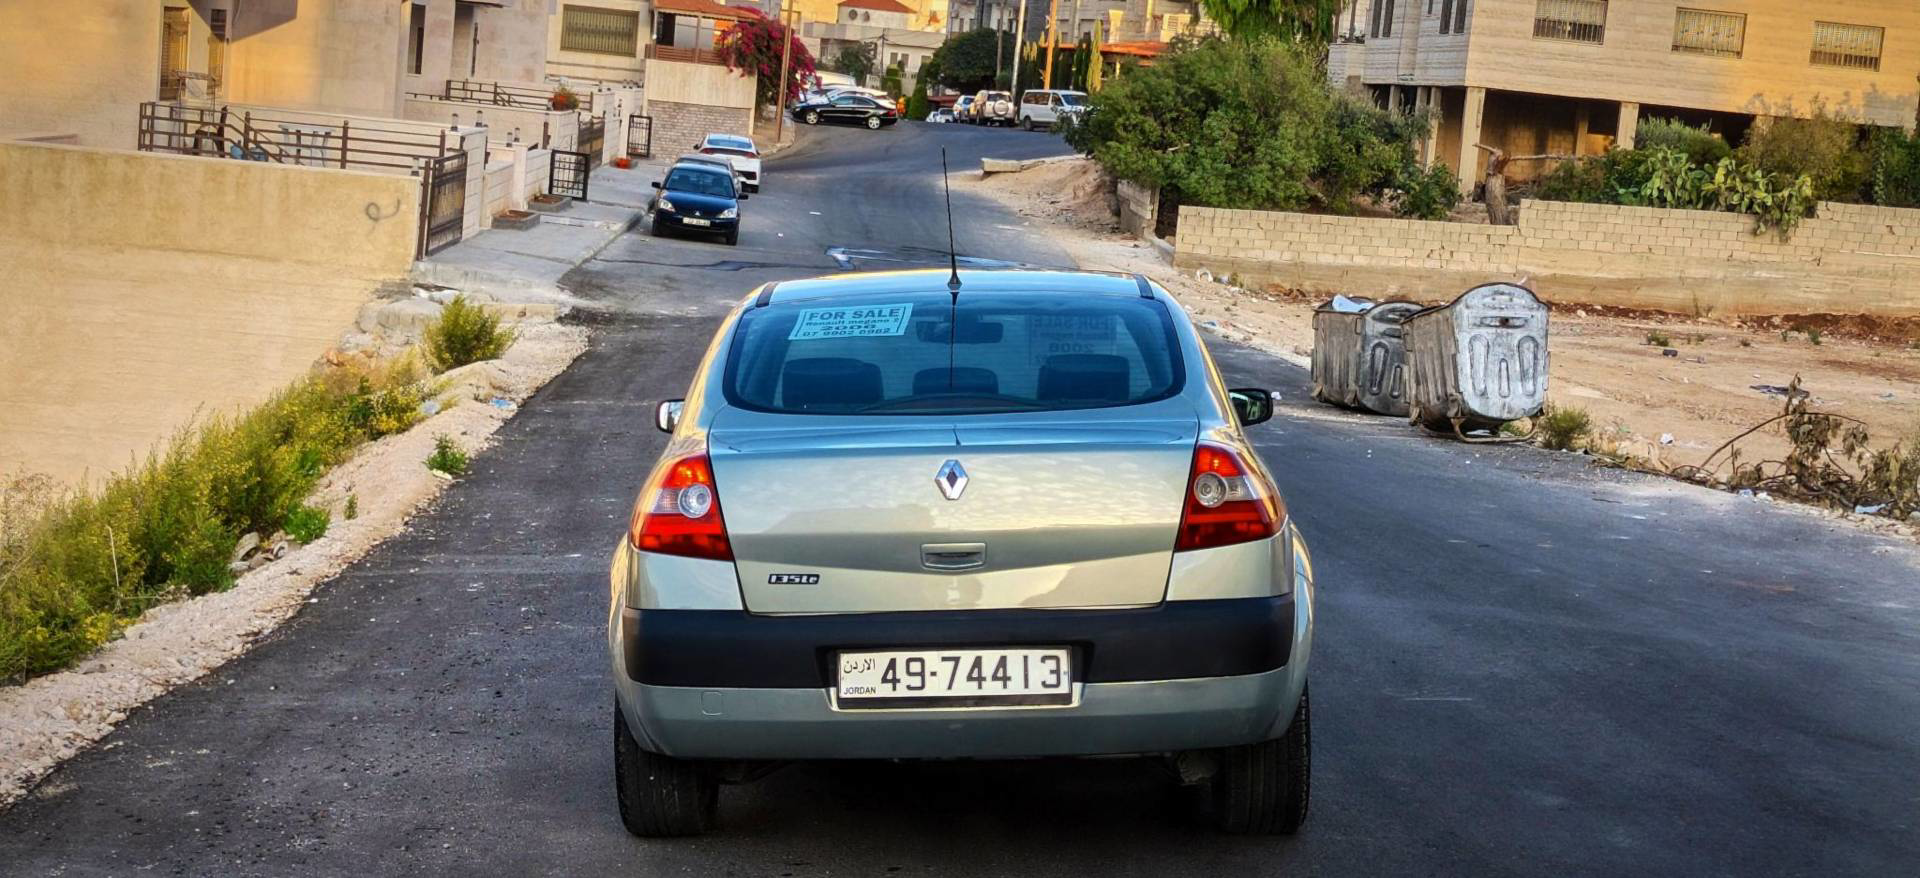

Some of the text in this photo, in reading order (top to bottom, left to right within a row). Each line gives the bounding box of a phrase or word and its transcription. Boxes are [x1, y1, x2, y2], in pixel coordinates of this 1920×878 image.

[809, 308, 901, 321] FOR SALE
[880, 655, 1061, 692] 49-74413
[843, 686, 876, 695] JORDAN
